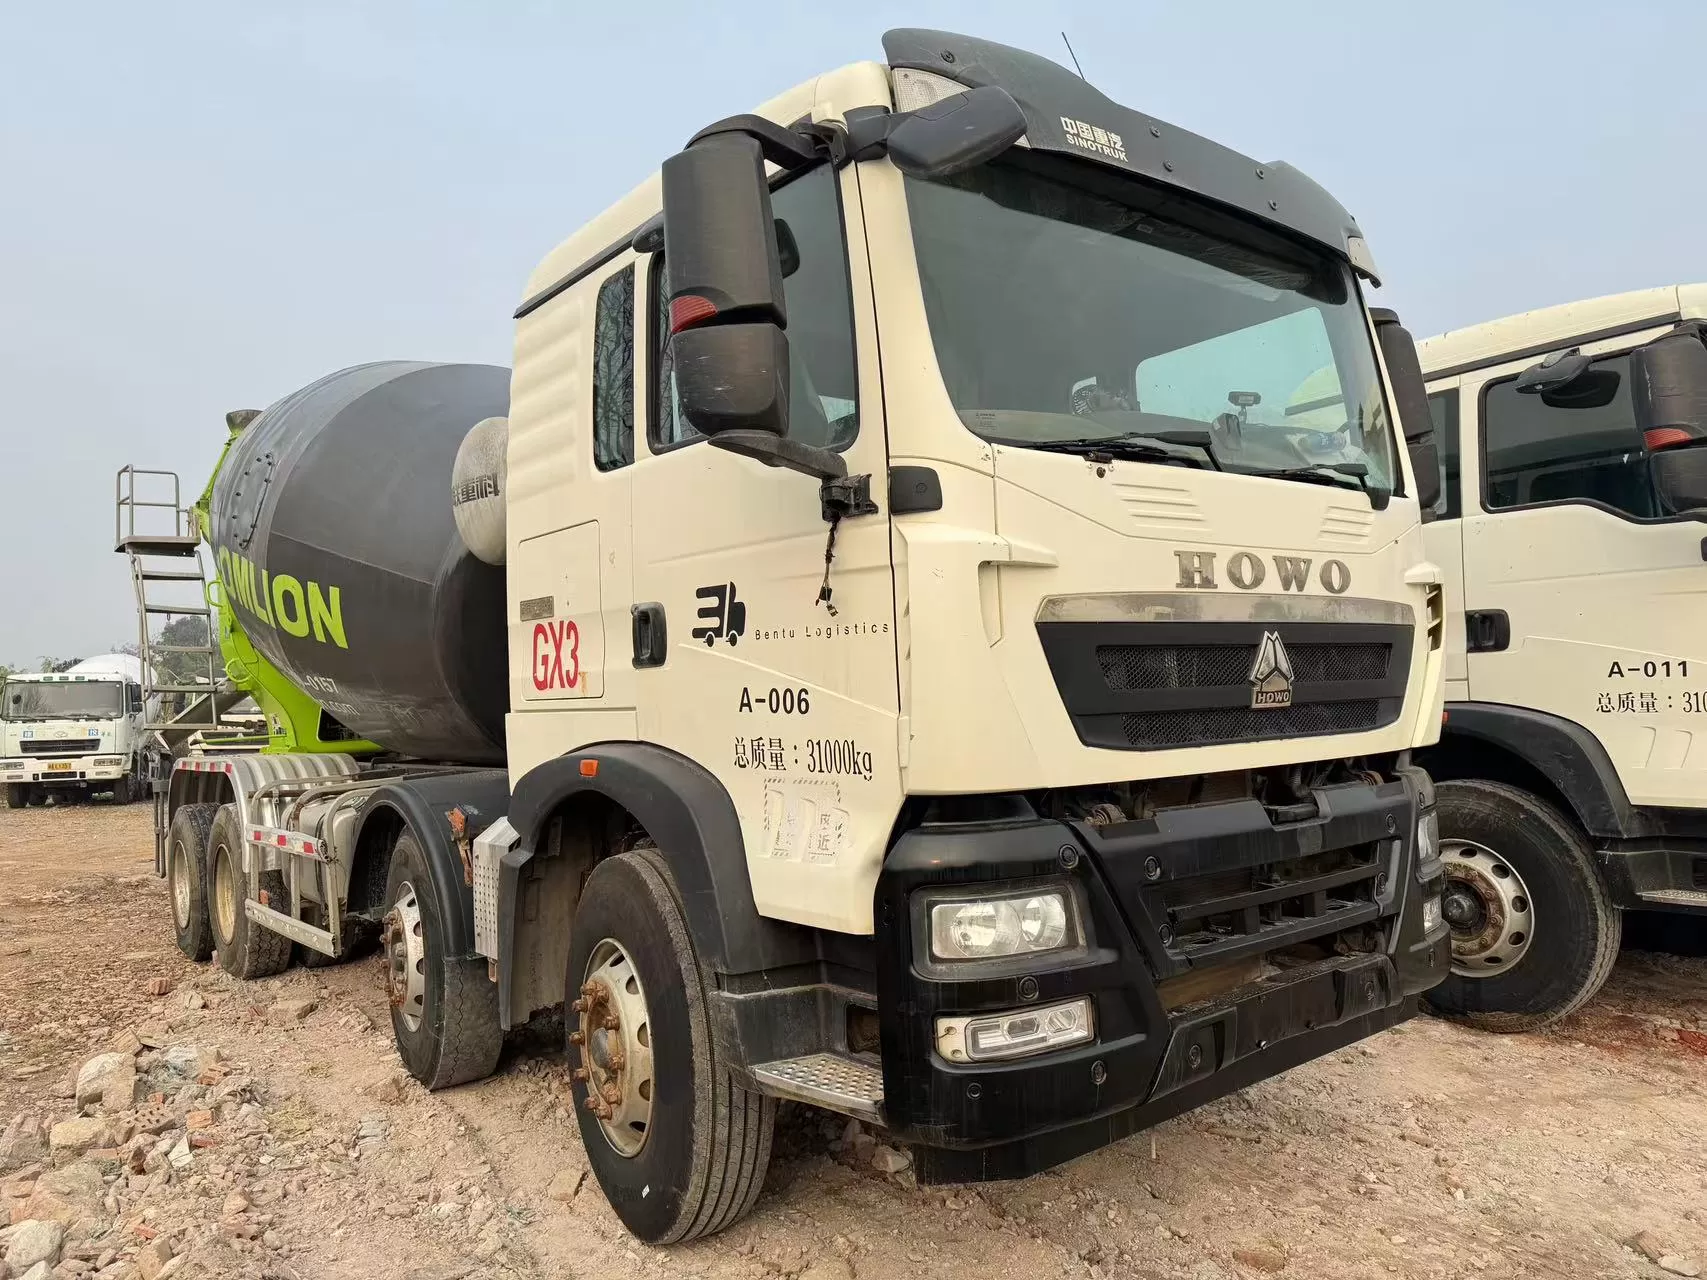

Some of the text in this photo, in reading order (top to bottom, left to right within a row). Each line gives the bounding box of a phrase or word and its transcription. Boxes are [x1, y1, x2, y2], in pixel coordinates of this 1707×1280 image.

[1060, 116, 1125, 151] 中国重汽
[1066, 134, 1128, 162] SINOTRUK
[1174, 550, 1351, 594] HOWO
[755, 622, 889, 640] Bentu Logistics
[532, 620, 579, 691] GX3
[1608, 661, 1688, 678] A-011
[739, 687, 810, 715] A-006
[1257, 691, 1290, 704] HOWO
